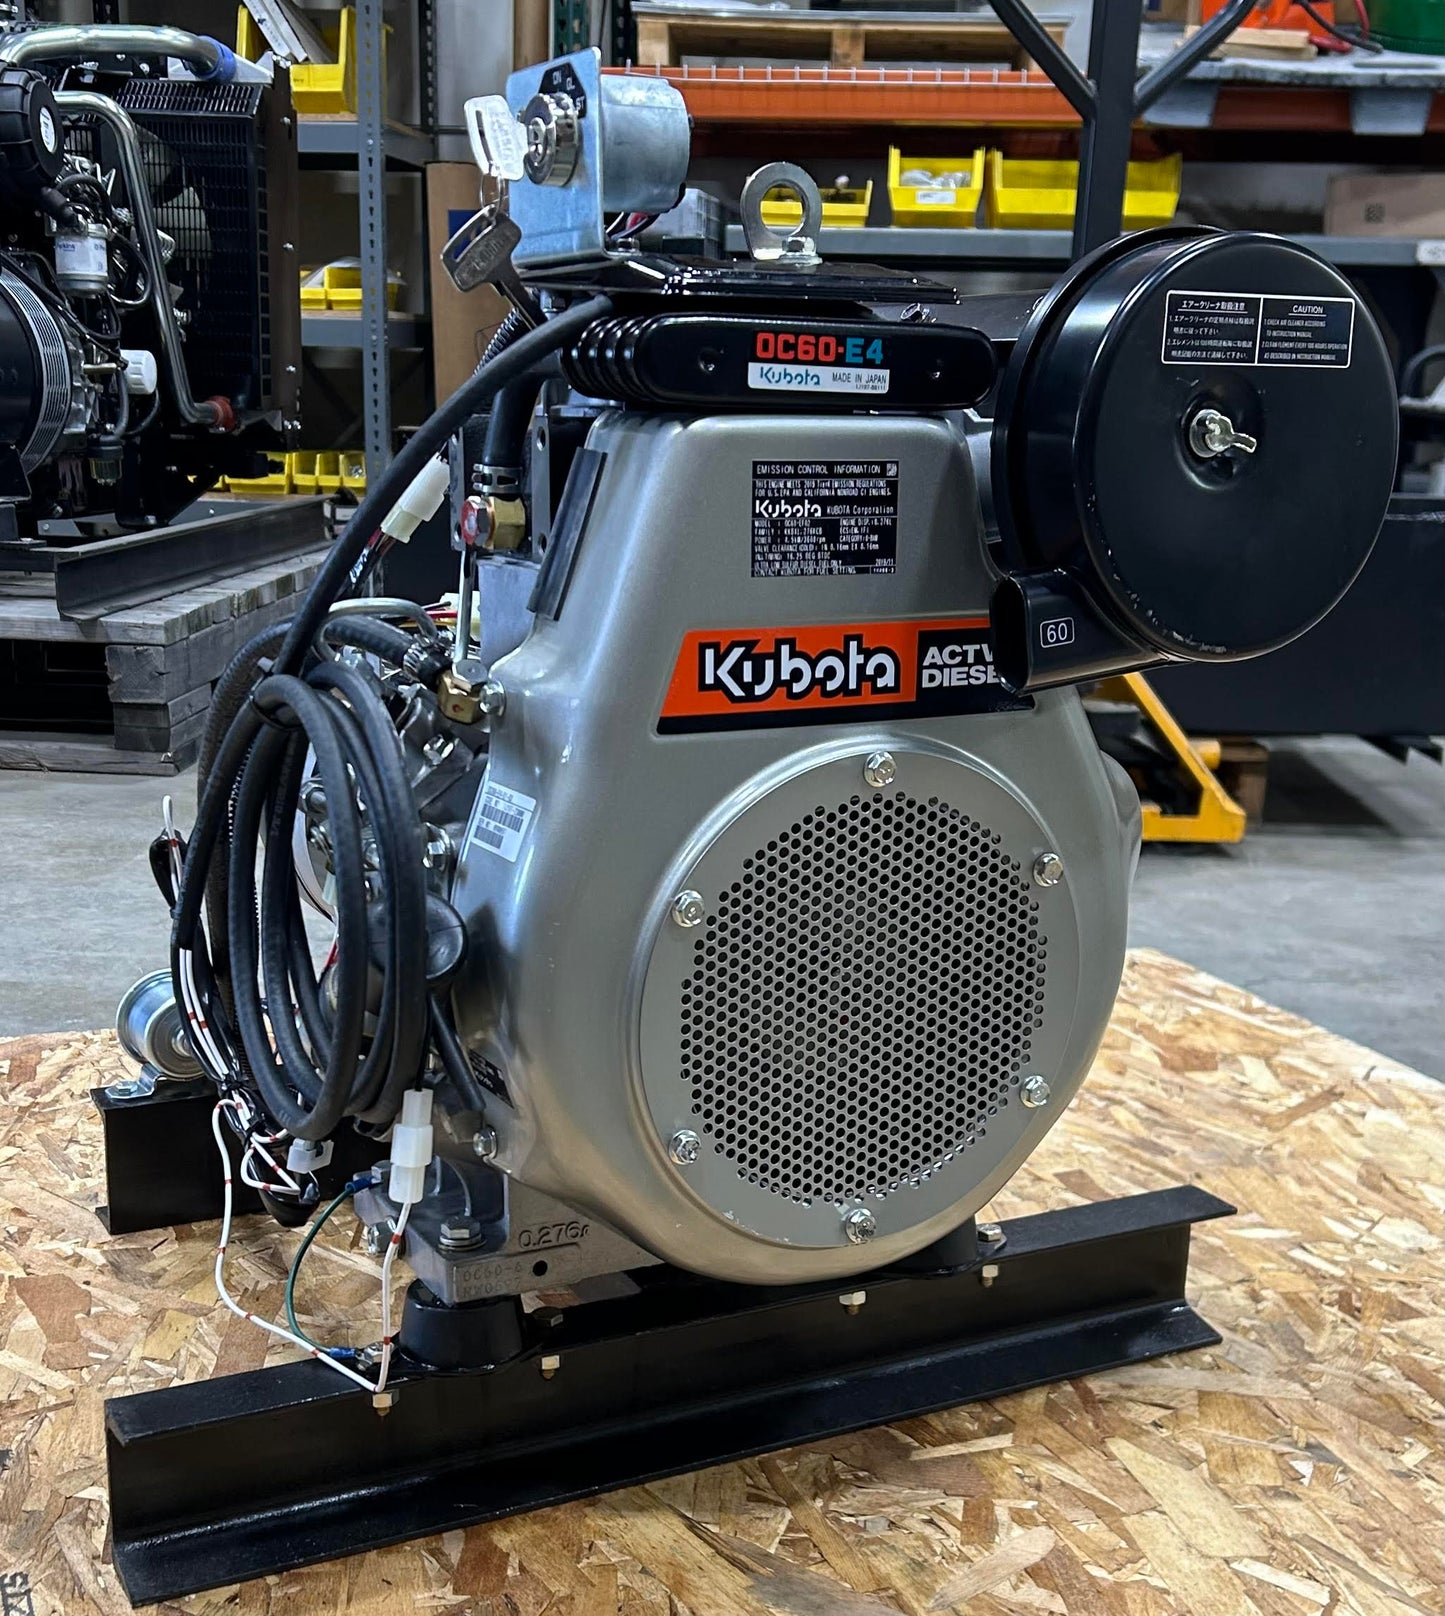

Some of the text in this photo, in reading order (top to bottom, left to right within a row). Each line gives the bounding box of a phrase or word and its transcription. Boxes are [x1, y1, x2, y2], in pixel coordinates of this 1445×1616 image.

[1292, 305, 1323, 314] CAUTION
[756, 332, 883, 364] OC60-E4
[760, 366, 820, 385] Kubota
[832, 372, 886, 384] MADE IN JAPAN
[757, 464, 880, 474] EMISSION CONTROL INFORMATION
[755, 480, 766, 488] THIS
[769, 480, 784, 488] ENGINE
[786, 480, 800, 488] MEETS
[755, 488, 765, 496] FOR
[792, 488, 802, 496] AND
[804, 488, 835, 496] CALIFORNIA
[837, 488, 858, 496] NONROAD
[756, 499, 821, 517] Kubota
[827, 505, 894, 515] KUBOTA Corporation
[1047, 622, 1068, 642] 60
[705, 640, 896, 696] Kubota
[922, 665, 1000, 688] DIESE
